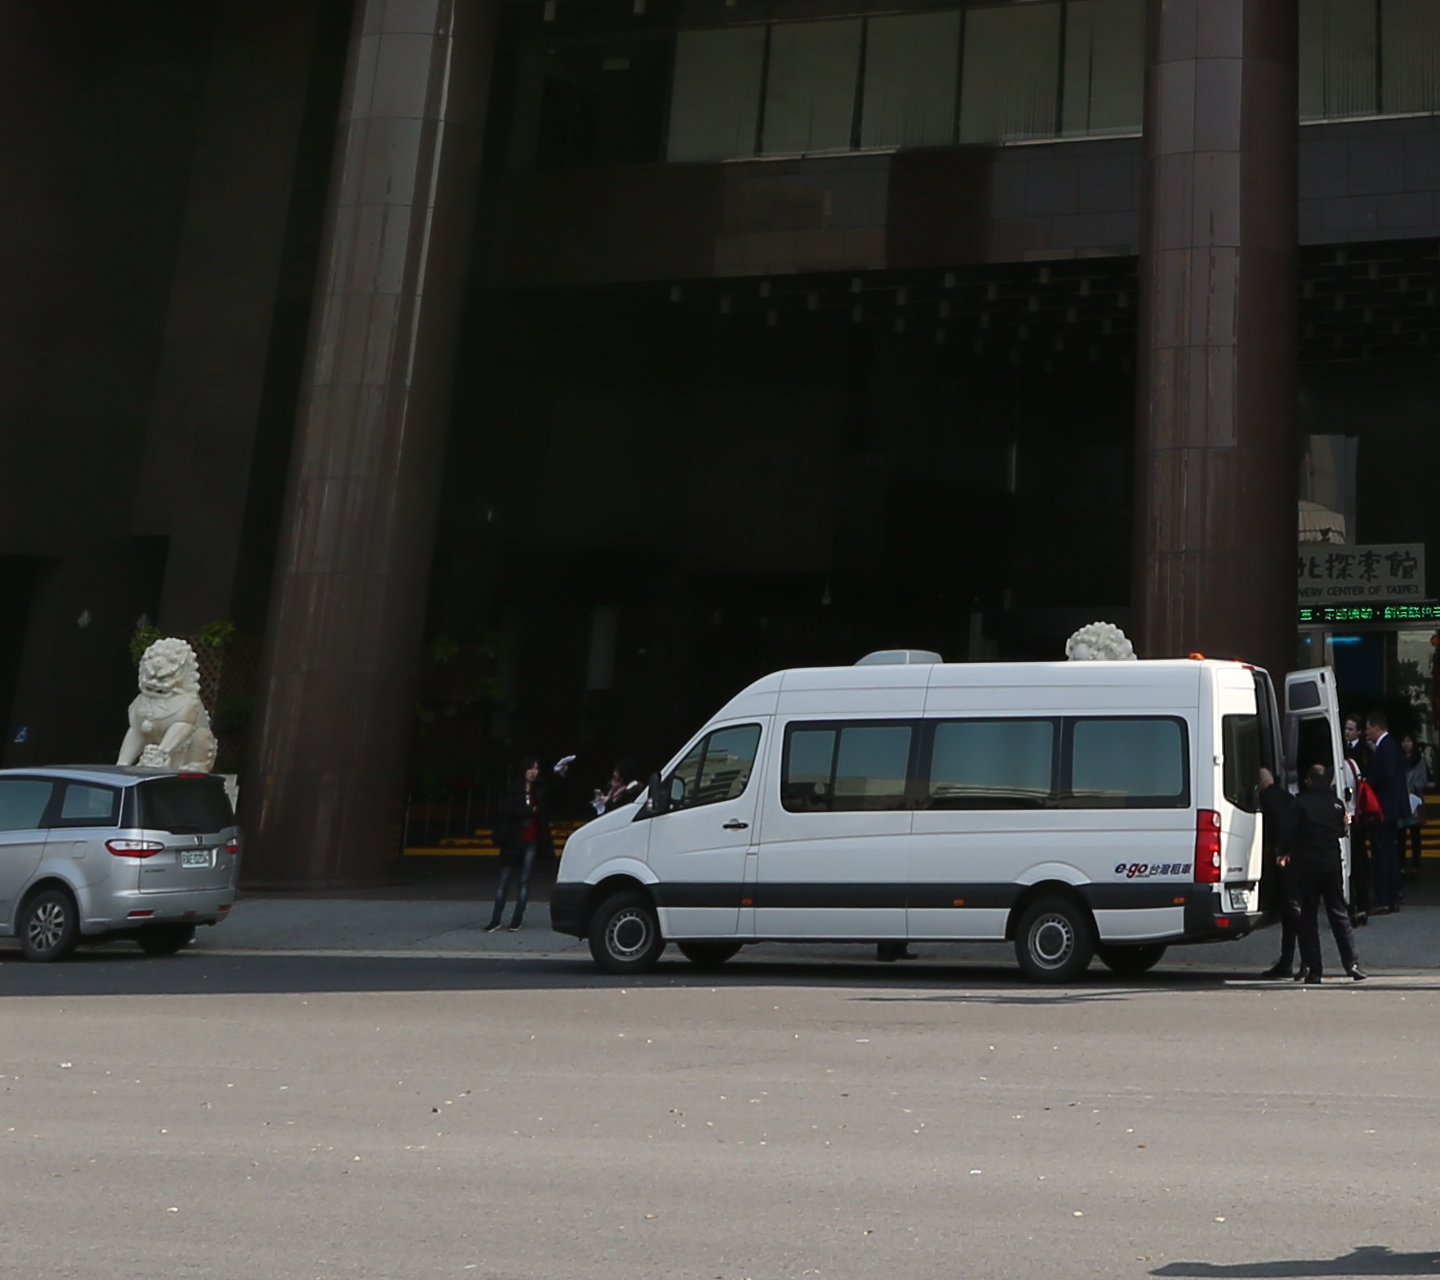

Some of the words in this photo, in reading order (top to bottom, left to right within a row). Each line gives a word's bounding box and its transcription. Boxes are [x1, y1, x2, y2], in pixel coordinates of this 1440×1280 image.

[1326, 586, 1365, 596] CENTER
[1368, 585, 1381, 595] OF
[1385, 584, 1420, 595] TAIPEI
